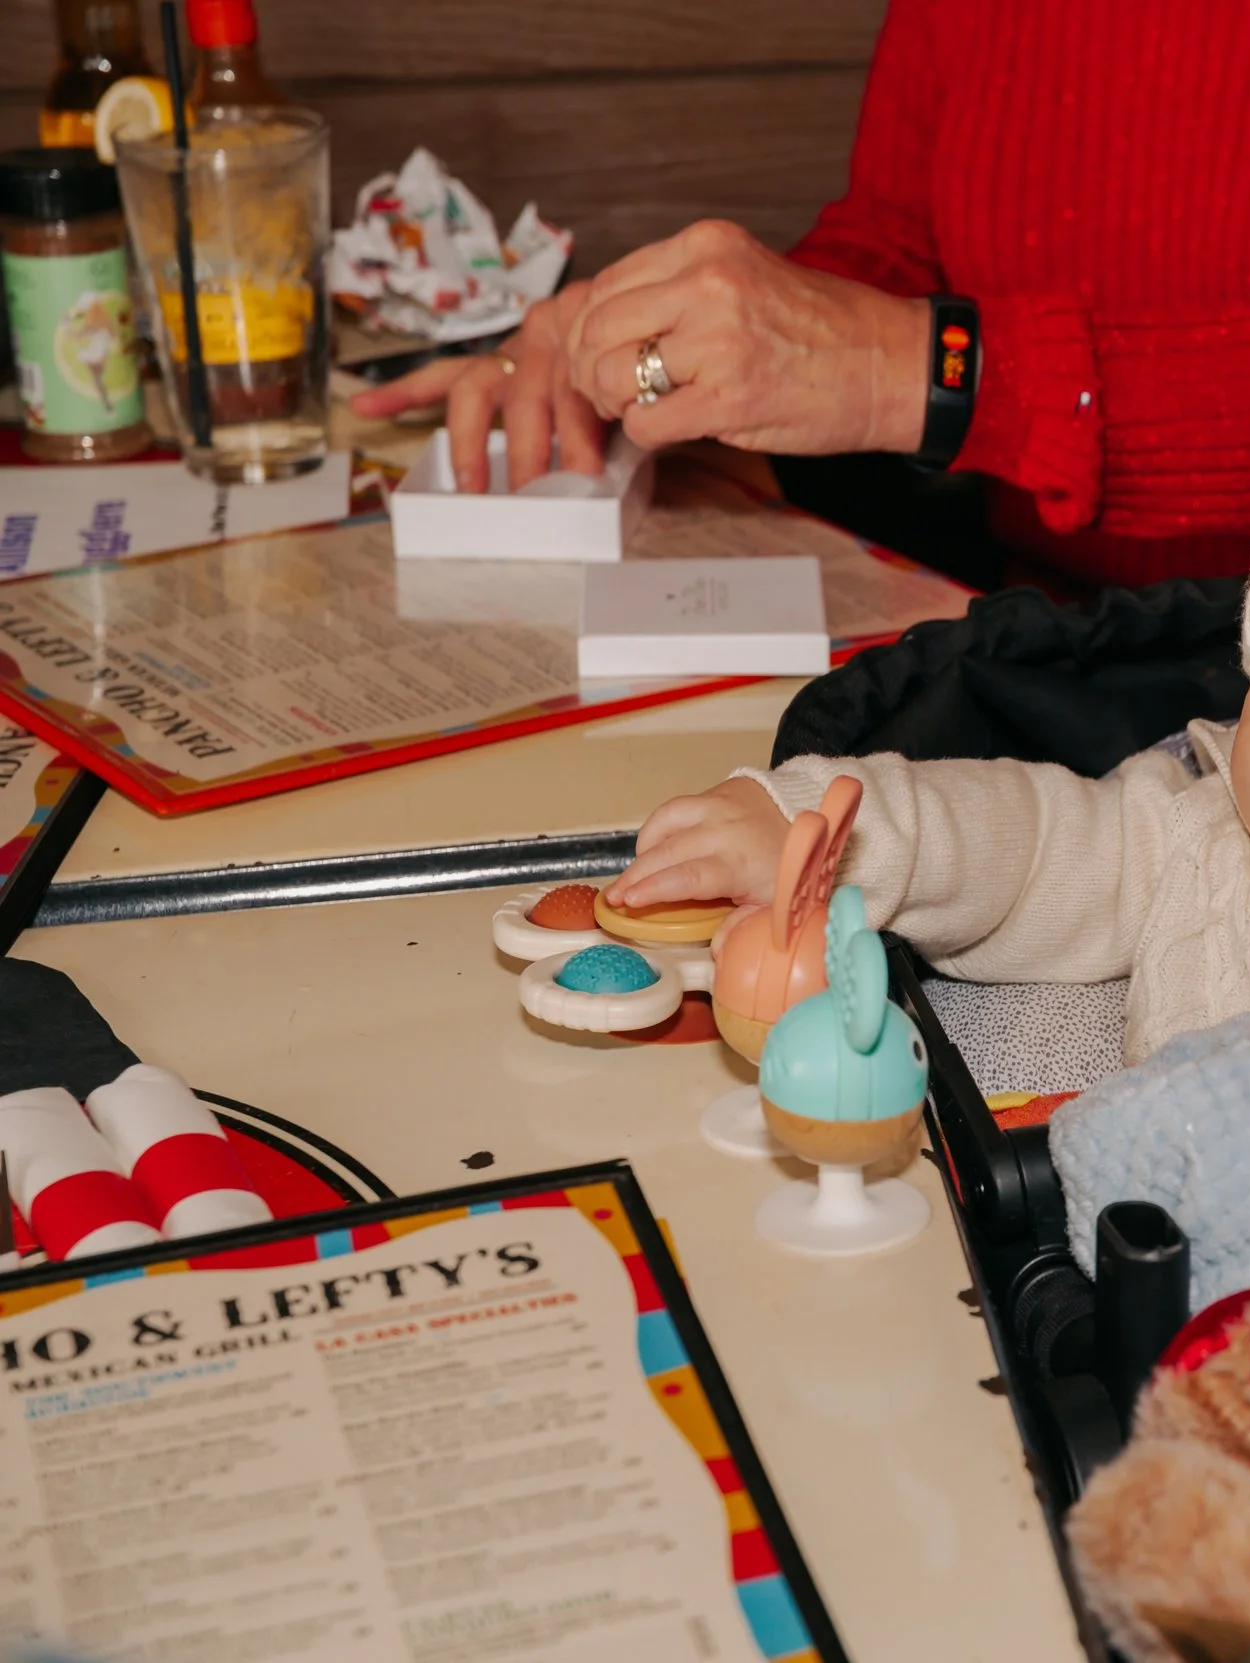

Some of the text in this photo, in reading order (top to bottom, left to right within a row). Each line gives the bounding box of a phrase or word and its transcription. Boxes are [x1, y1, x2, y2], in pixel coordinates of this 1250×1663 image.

[103, 684, 237, 759] PANCHO
[131, 1308, 183, 1347] &
[220, 1241, 541, 1330] LEFTY'S
[10, 1329, 302, 1393] MEXICAN GRILL
